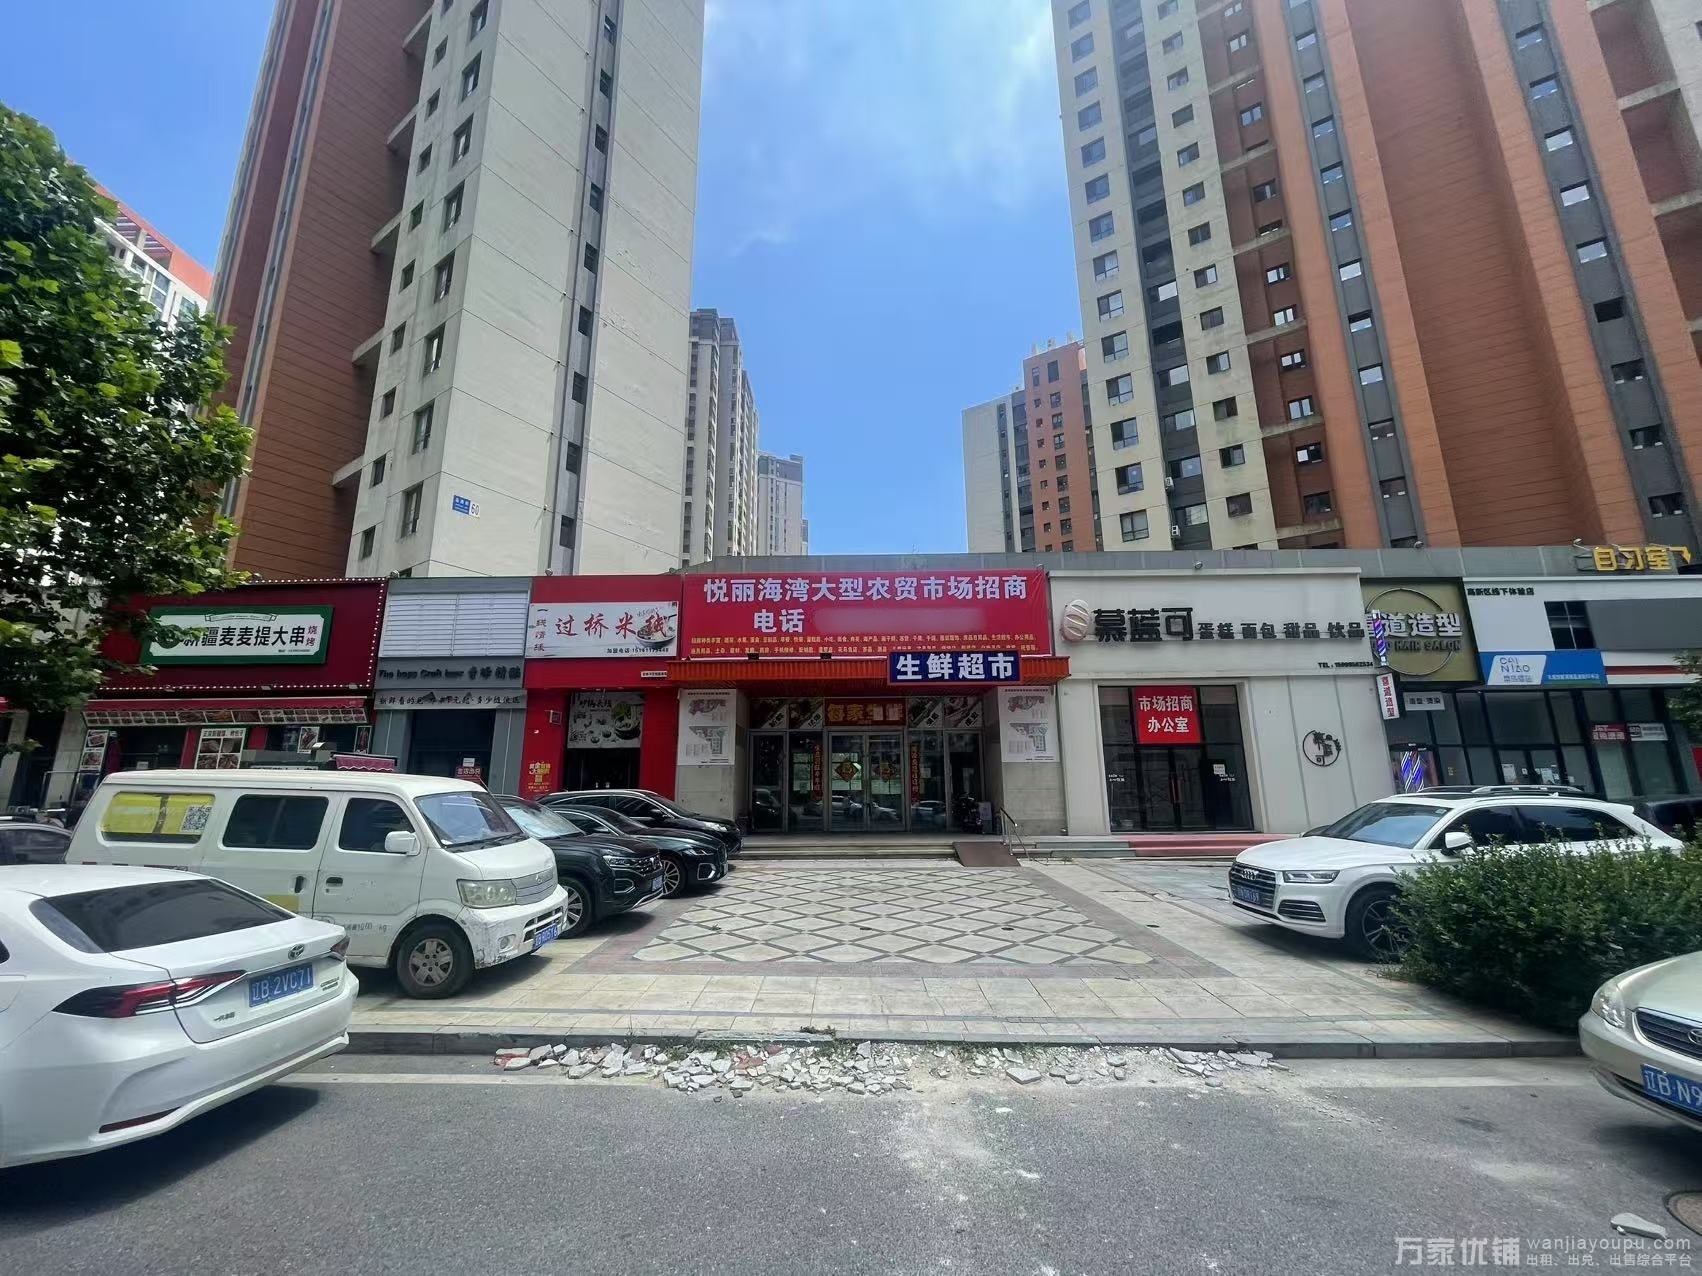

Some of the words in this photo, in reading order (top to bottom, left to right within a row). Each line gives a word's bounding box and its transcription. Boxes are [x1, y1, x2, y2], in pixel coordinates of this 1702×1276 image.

[704, 576, 1027, 603] 悦丽海湾大型农贸市场招商
[555, 611, 668, 639] 过桥米线
[754, 608, 805, 634] 电话
[1198, 622, 1235, 640] 蛋糕
[1241, 622, 1276, 639] 面包
[1283, 622, 1321, 639] 甜品
[1327, 621, 1365, 639] 饮品
[896, 653, 1015, 681] 生鲜超市
[1138, 695, 1193, 713] 市场招商
[1148, 716, 1190, 733] 办公室
